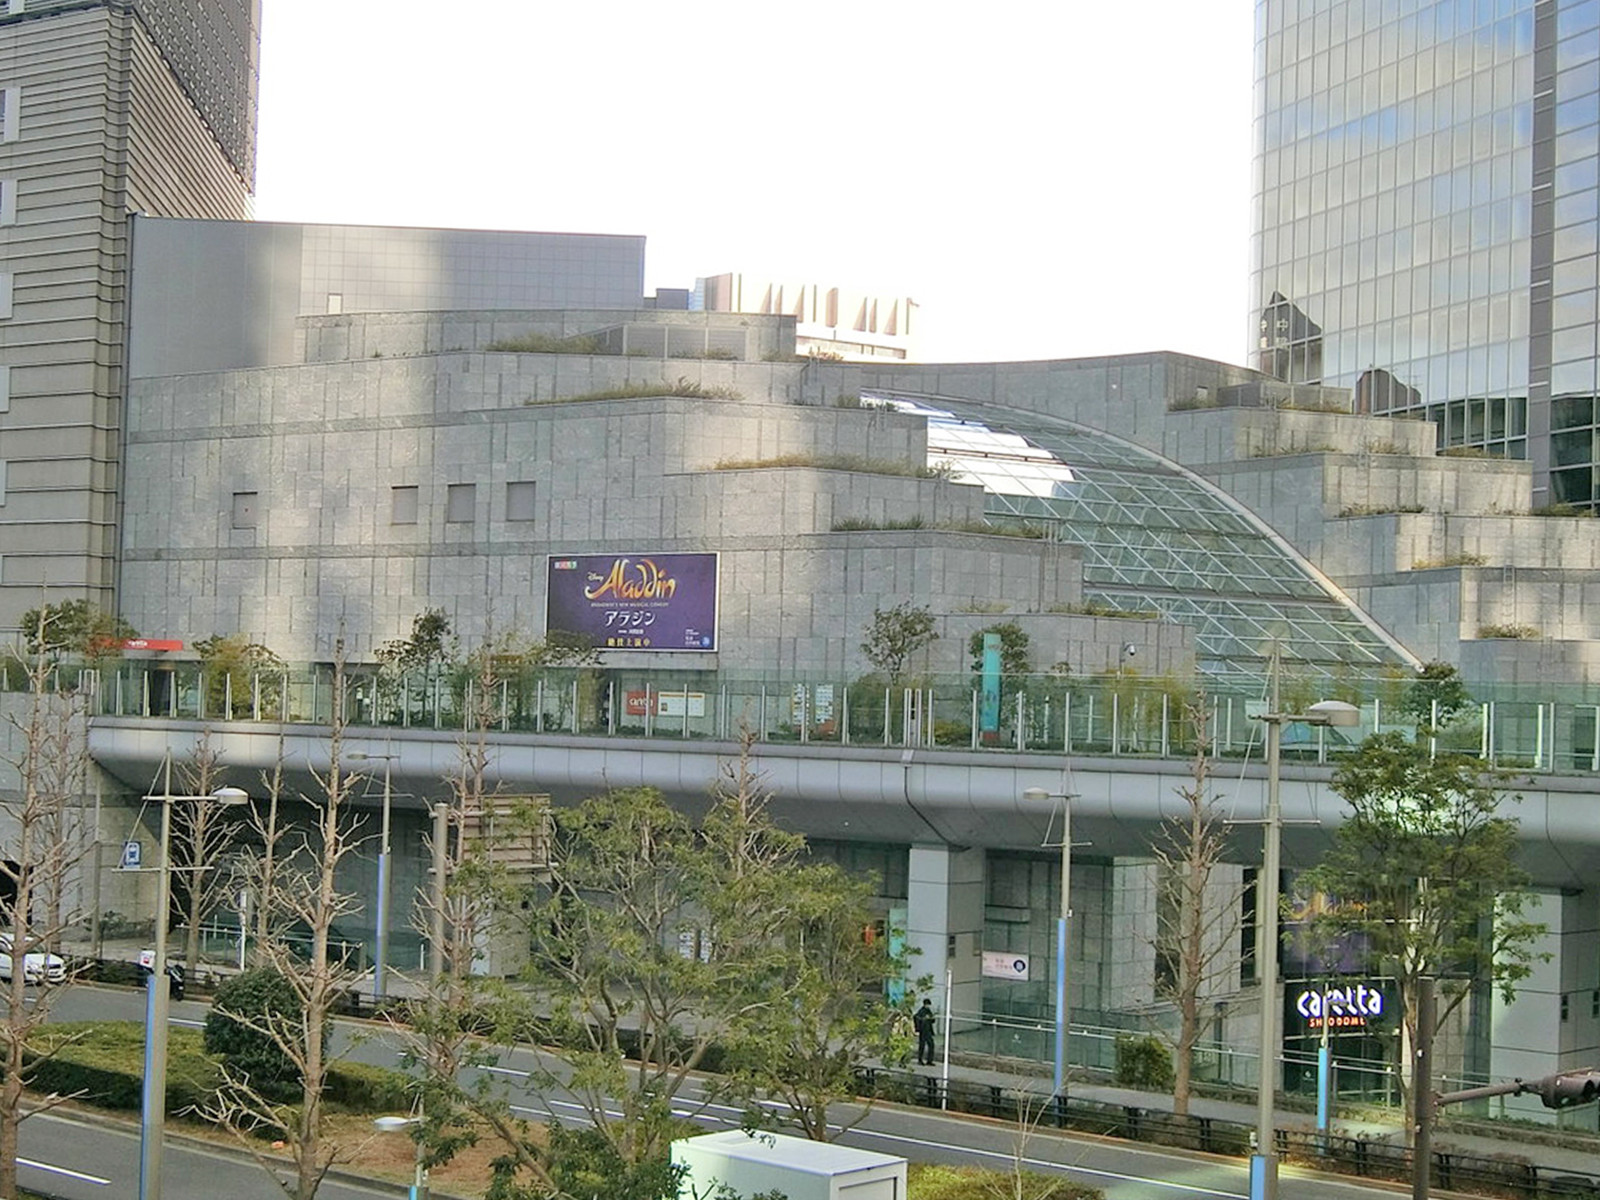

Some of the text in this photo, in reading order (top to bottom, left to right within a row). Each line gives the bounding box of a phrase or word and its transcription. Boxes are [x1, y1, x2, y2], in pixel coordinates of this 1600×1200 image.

[584, 558, 676, 600] Aladdin
[604, 610, 656, 627] アラジン
[1308, 1016, 1366, 1028] SHODOME
